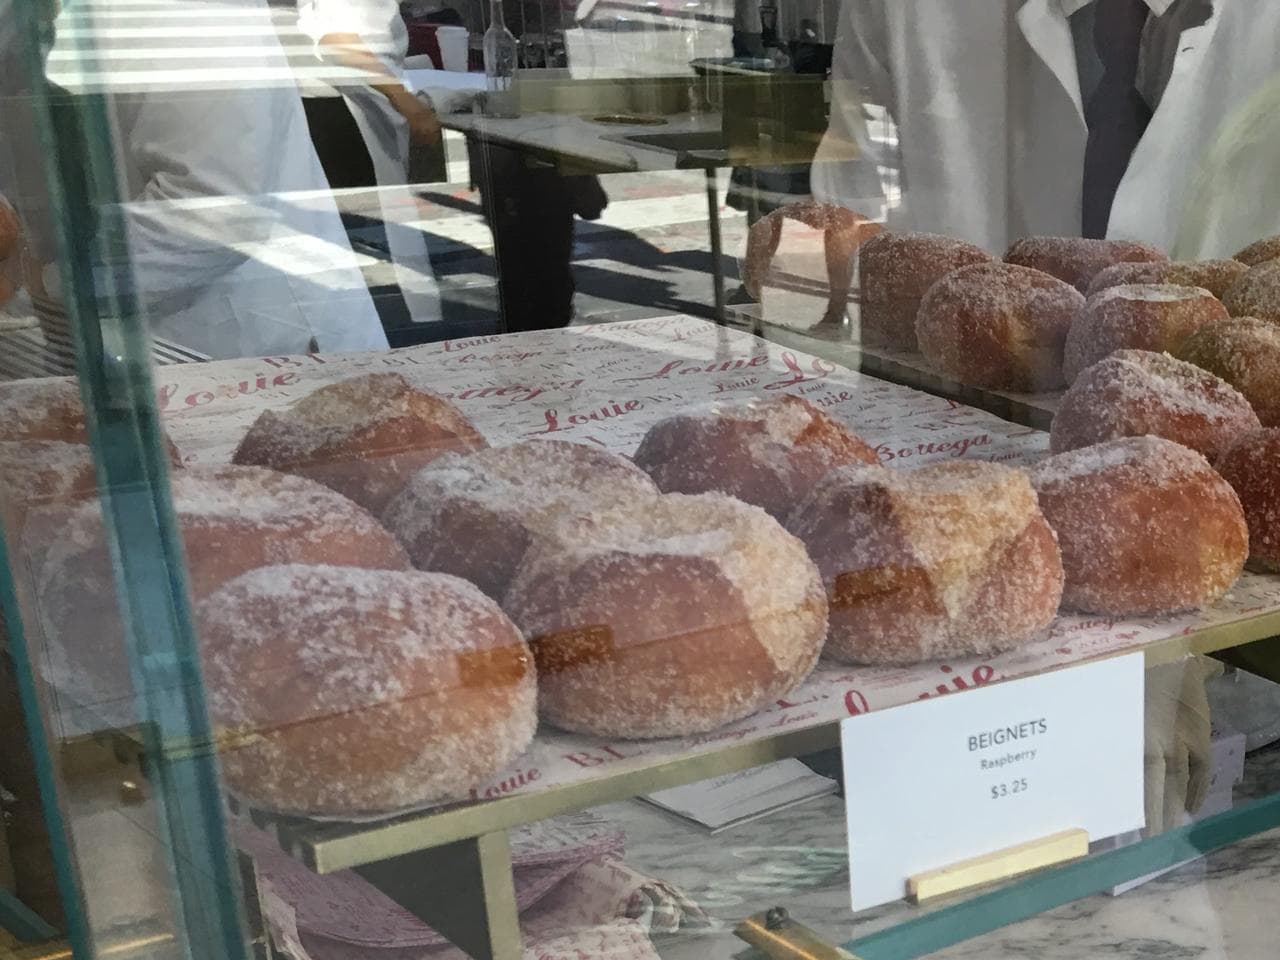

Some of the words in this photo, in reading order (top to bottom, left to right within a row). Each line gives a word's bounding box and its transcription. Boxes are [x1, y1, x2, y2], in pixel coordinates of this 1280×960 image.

[519, 399, 645, 438] Louie
[968, 718, 1047, 752] BEIGNETS
[980, 749, 1037, 770] Raspberry
[991, 778, 1028, 800] $3.25
